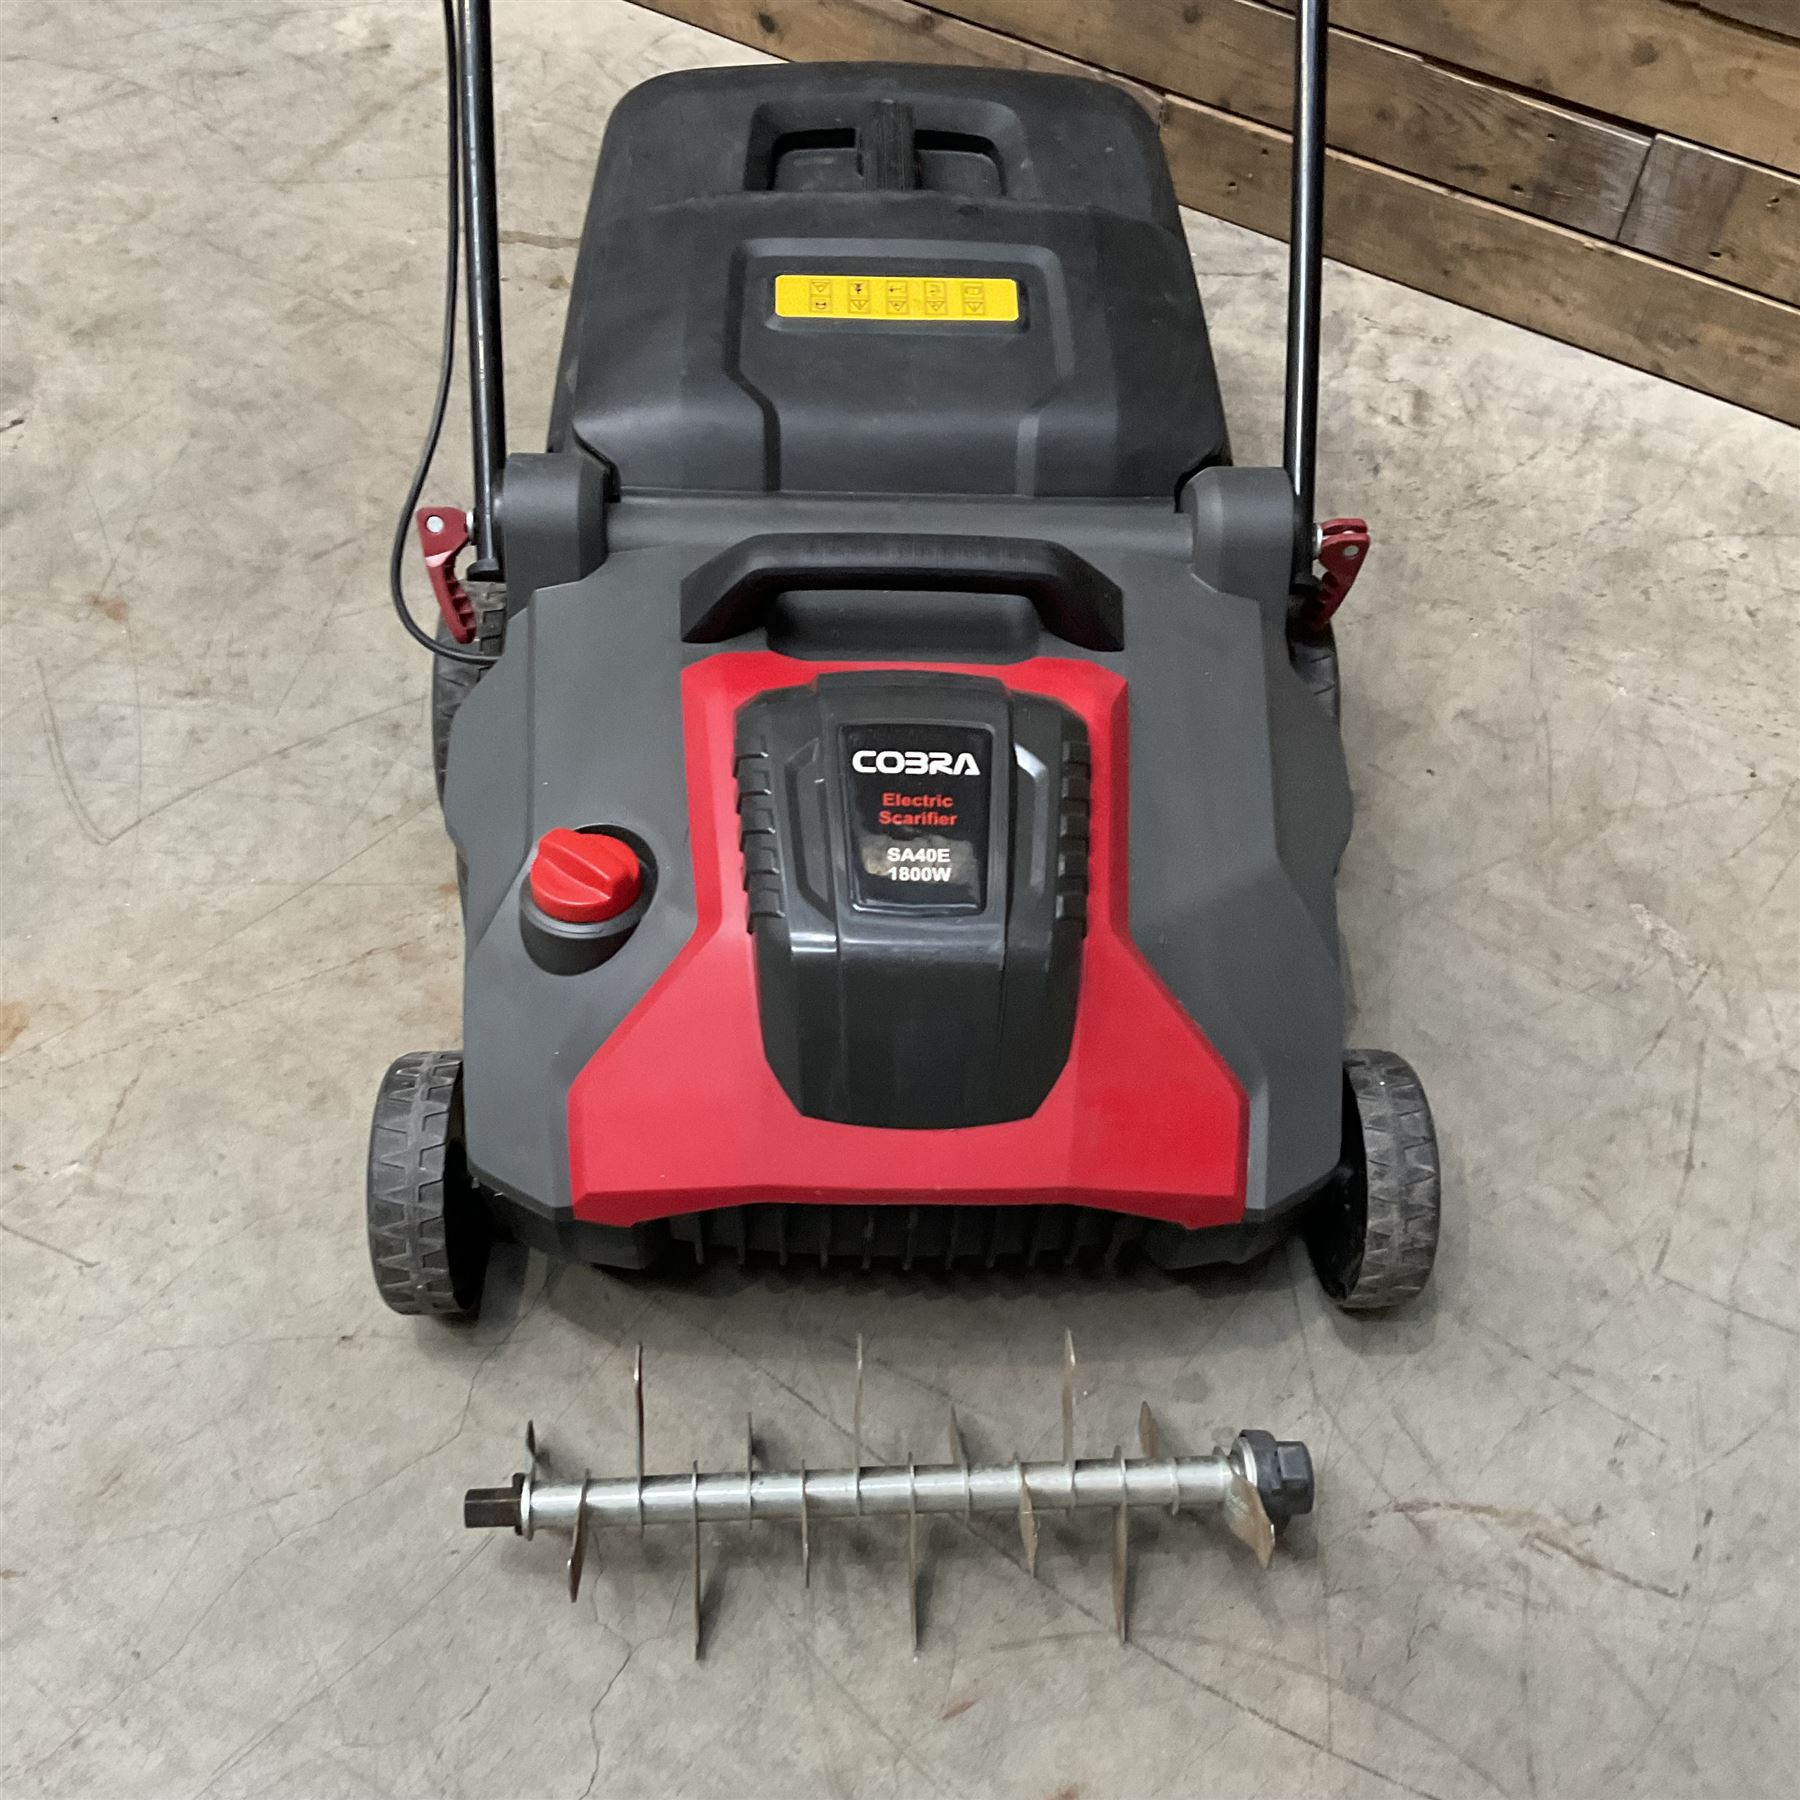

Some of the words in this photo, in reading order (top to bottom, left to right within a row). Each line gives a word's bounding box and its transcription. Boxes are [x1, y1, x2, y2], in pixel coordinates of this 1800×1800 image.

[852, 750, 980, 775] COBRA
[882, 792, 953, 808] Electric
[879, 810, 957, 826] Scarifier
[887, 847, 950, 863] SA40E
[888, 867, 952, 882] 1800W
